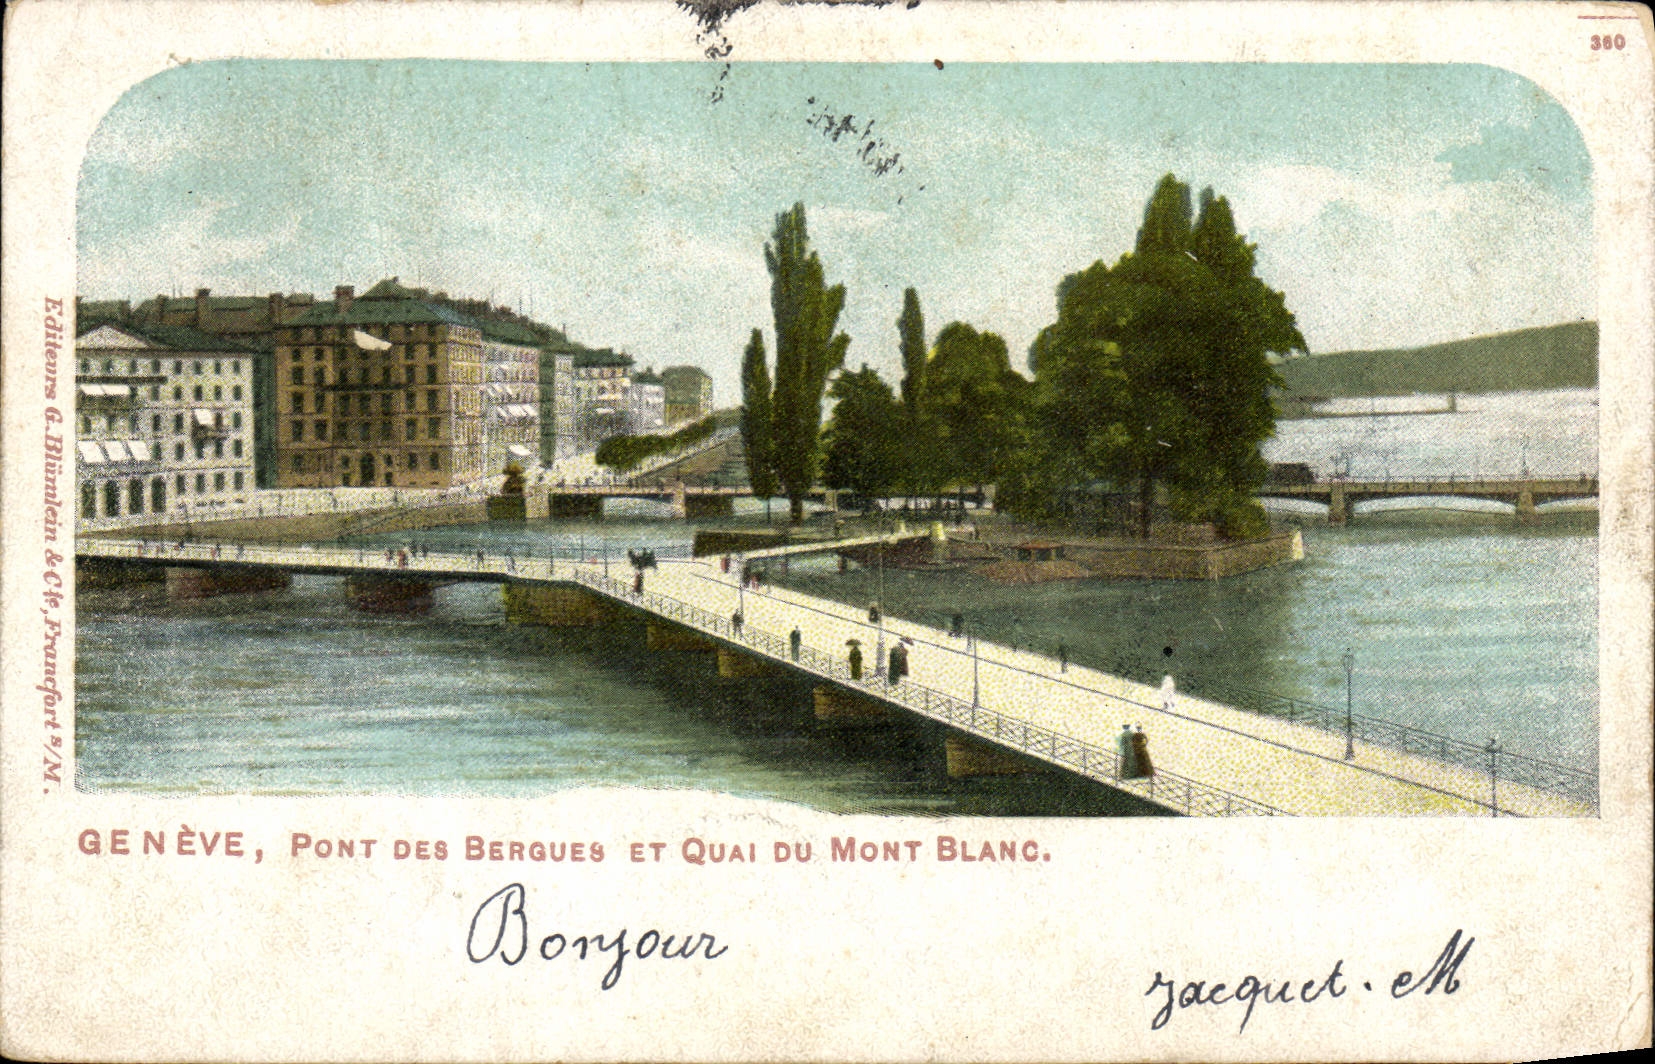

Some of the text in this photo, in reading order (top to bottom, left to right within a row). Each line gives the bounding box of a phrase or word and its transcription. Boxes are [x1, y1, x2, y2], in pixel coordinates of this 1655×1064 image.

[44, 297, 63, 399] Editeurs
[78, 823, 1052, 866] GENÈVE, PONT DES BERGUES ET QUAI DU MONT BLANC.
[466, 883, 729, 991] Bonjour
